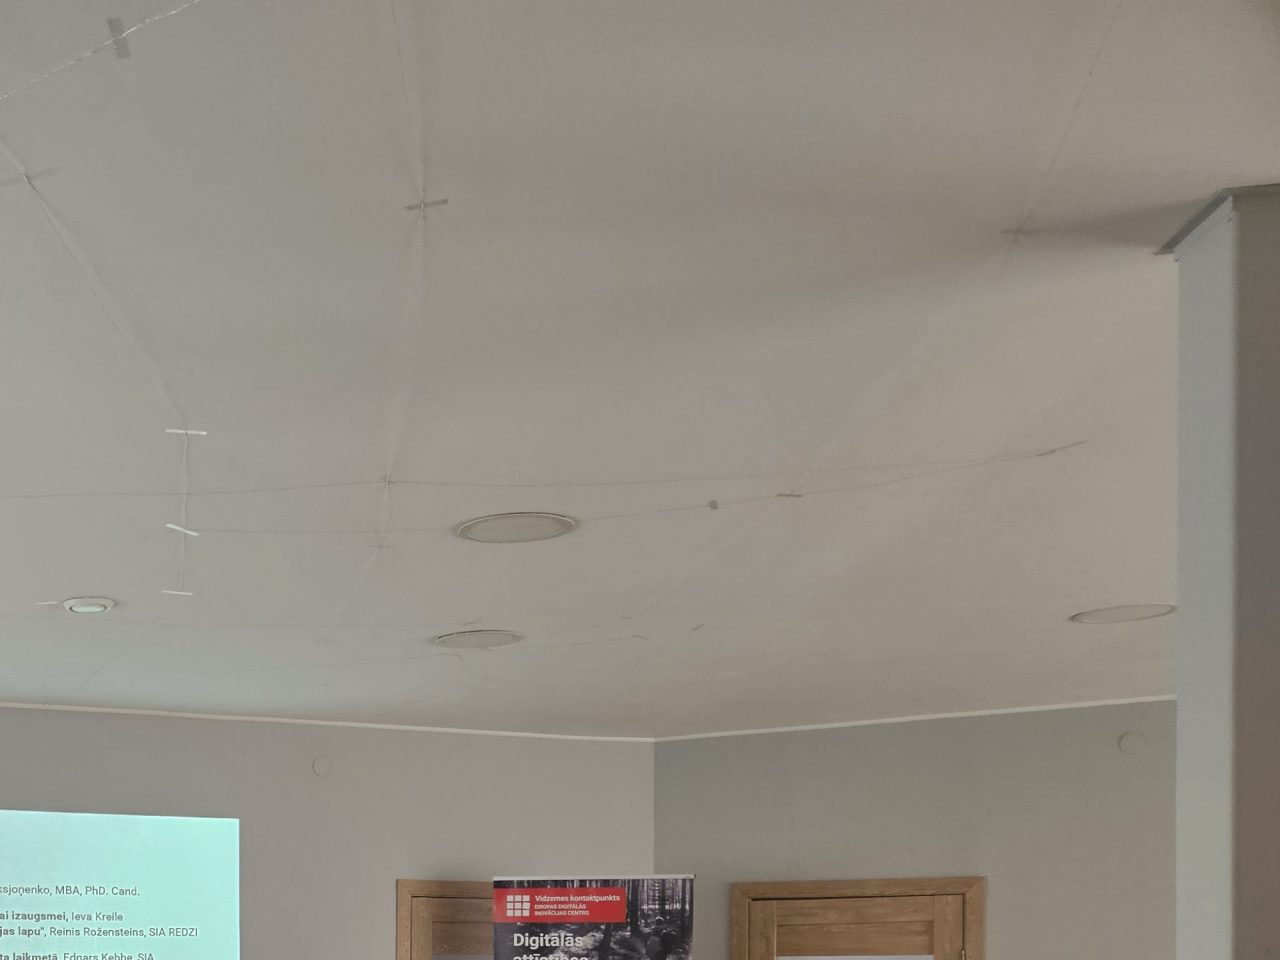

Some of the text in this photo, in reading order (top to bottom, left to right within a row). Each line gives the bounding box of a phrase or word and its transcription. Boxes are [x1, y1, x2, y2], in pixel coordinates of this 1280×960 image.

[56, 885, 83, 896] MBA,
[85, 886, 109, 896] PhD.
[112, 886, 141, 896] Cand.
[12, 912, 69, 922] izaugsmei,
[72, 912, 92, 921] Ieva
[96, 912, 123, 921] Kreile
[50, 927, 80, 936] Reinis
[84, 927, 147, 938] Rožensteins,
[149, 928, 166, 936] SIA
[169, 928, 198, 937] REDZI
[513, 932, 583, 949] Digitālās
